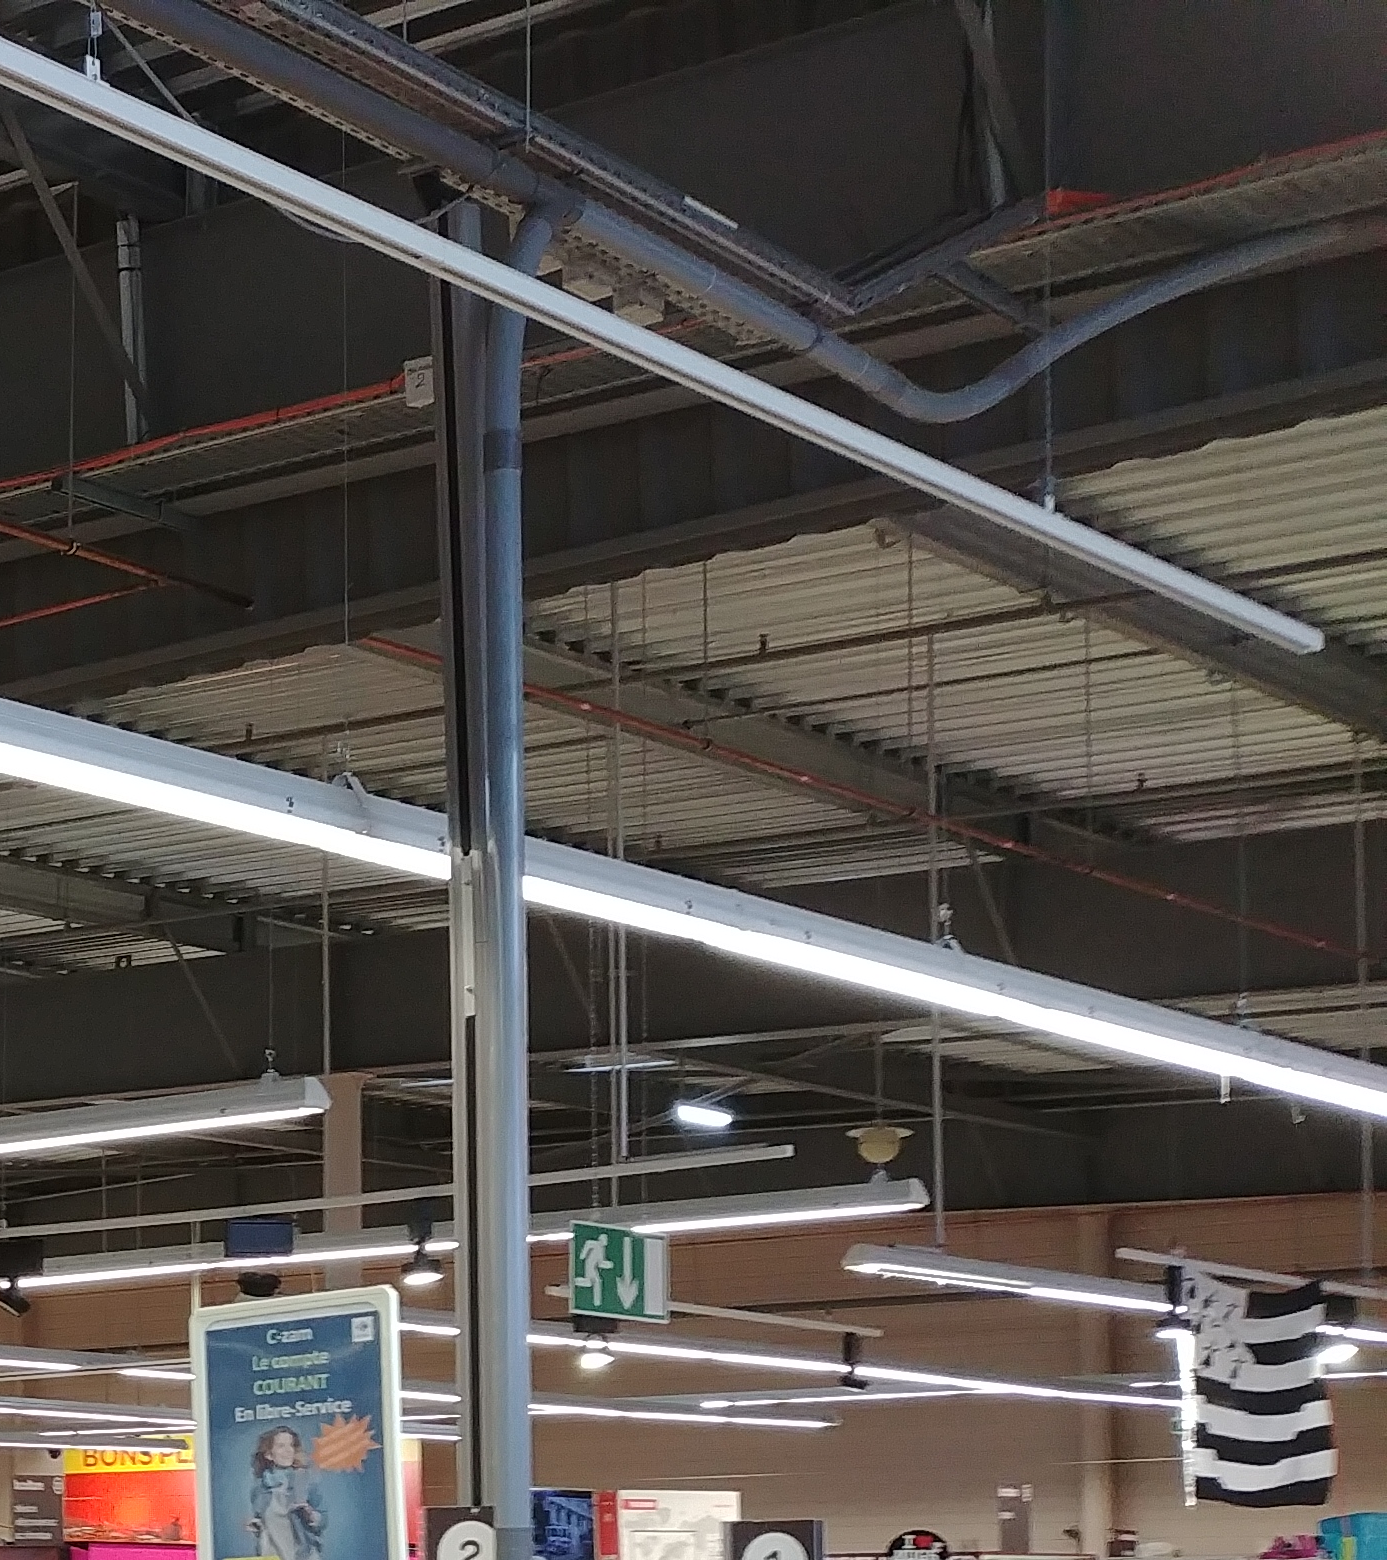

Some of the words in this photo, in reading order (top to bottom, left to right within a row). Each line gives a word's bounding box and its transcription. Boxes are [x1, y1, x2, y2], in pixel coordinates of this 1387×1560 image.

[252, 1356, 269, 1371] Le
[271, 1350, 330, 1369] compte
[253, 1373, 330, 1395] COURANT
[234, 1406, 254, 1423] En
[83, 1448, 152, 1467] BONS
